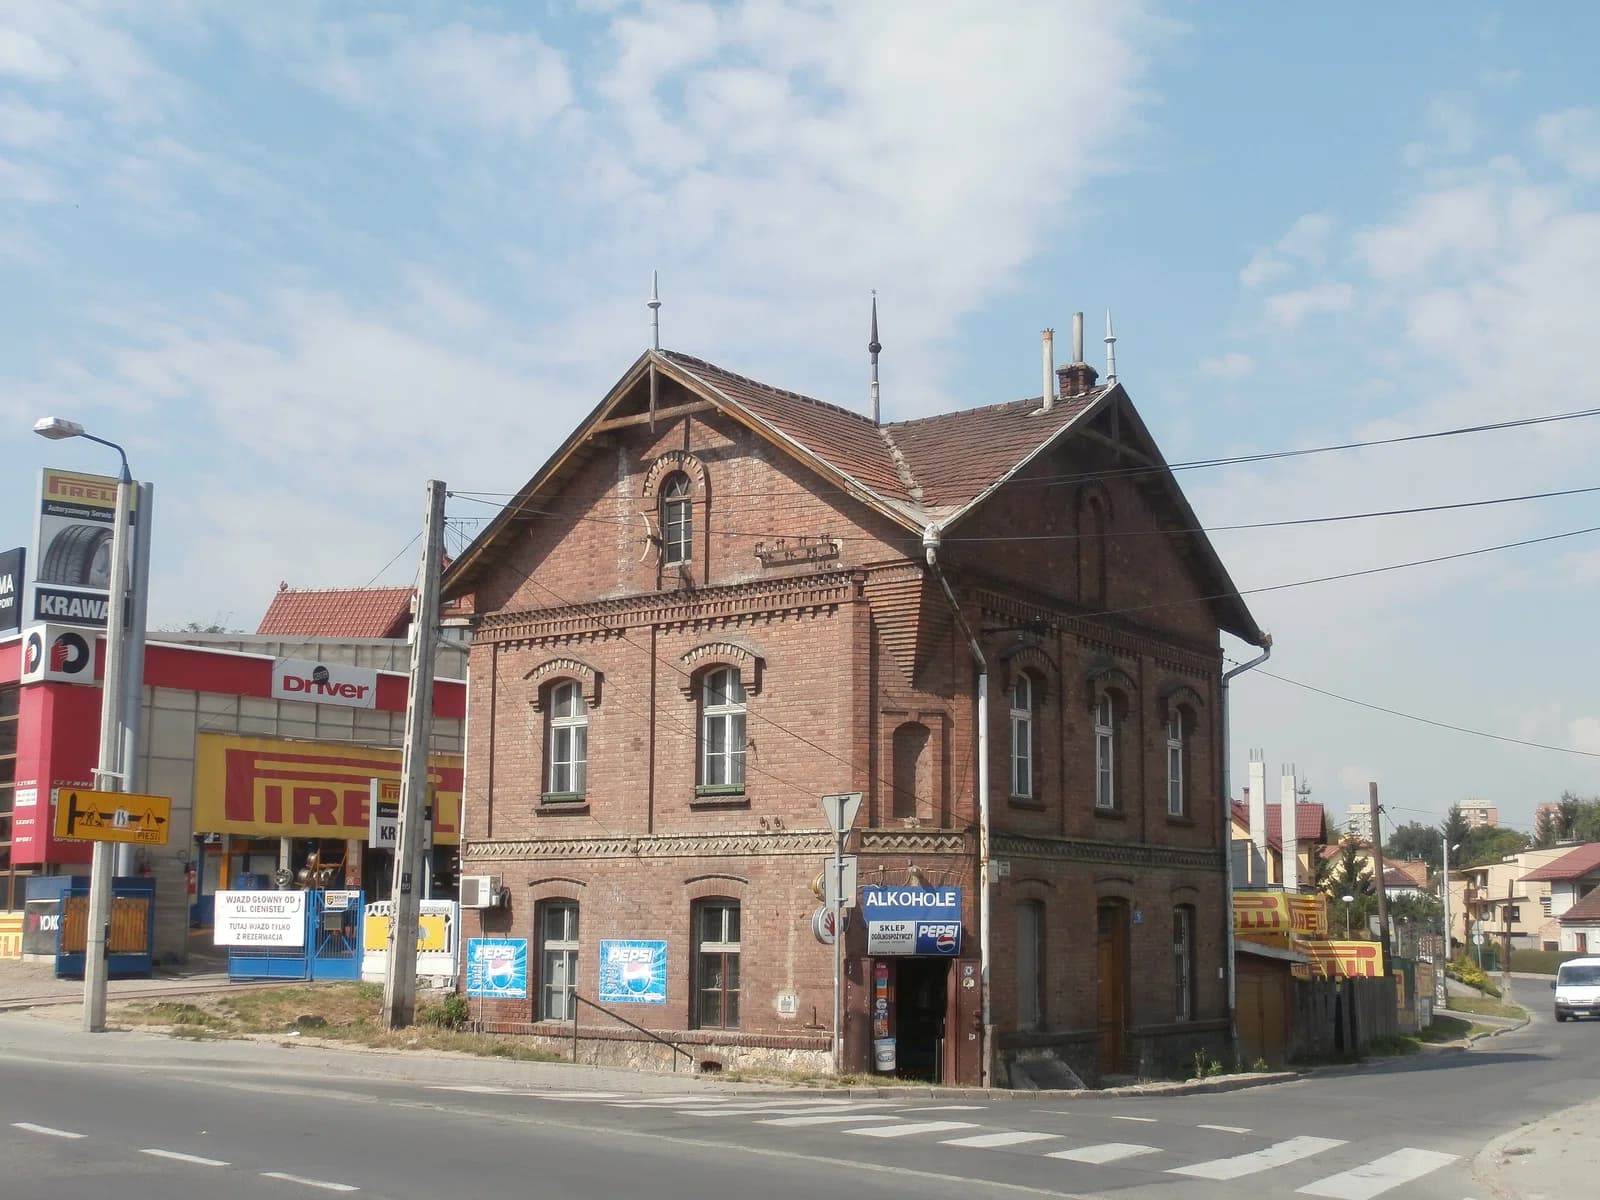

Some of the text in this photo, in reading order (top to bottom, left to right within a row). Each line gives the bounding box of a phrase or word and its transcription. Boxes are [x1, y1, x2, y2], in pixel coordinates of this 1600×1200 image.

[283, 673, 369, 699] Driver
[226, 896, 251, 904] WJAZD
[284, 896, 295, 904] OD
[866, 892, 956, 907] ALKOHOLE
[918, 925, 958, 938] PEPSI
[475, 945, 516, 961] PEPSI
[609, 948, 654, 963] PEPSI
